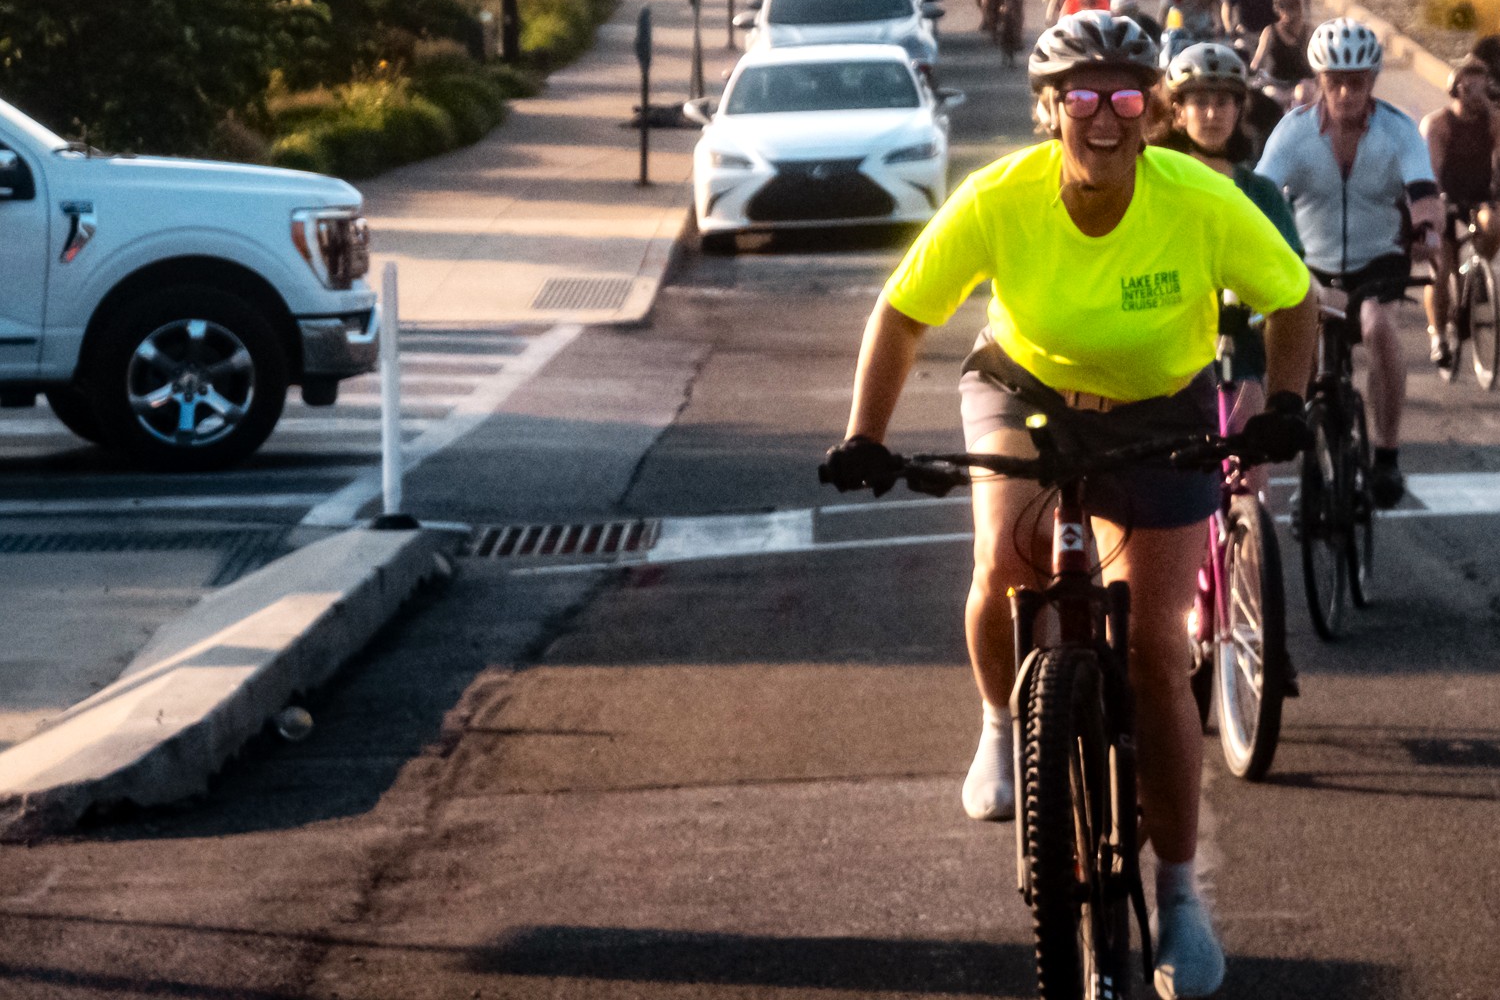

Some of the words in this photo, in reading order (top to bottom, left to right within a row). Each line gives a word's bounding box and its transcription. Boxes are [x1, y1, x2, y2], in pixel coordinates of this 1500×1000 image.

[1121, 274, 1151, 289] LAKE
[1154, 270, 1179, 286] ERIE
[1121, 282, 1180, 301] INTERCLUB
[1122, 297, 1158, 311] CRUISE
